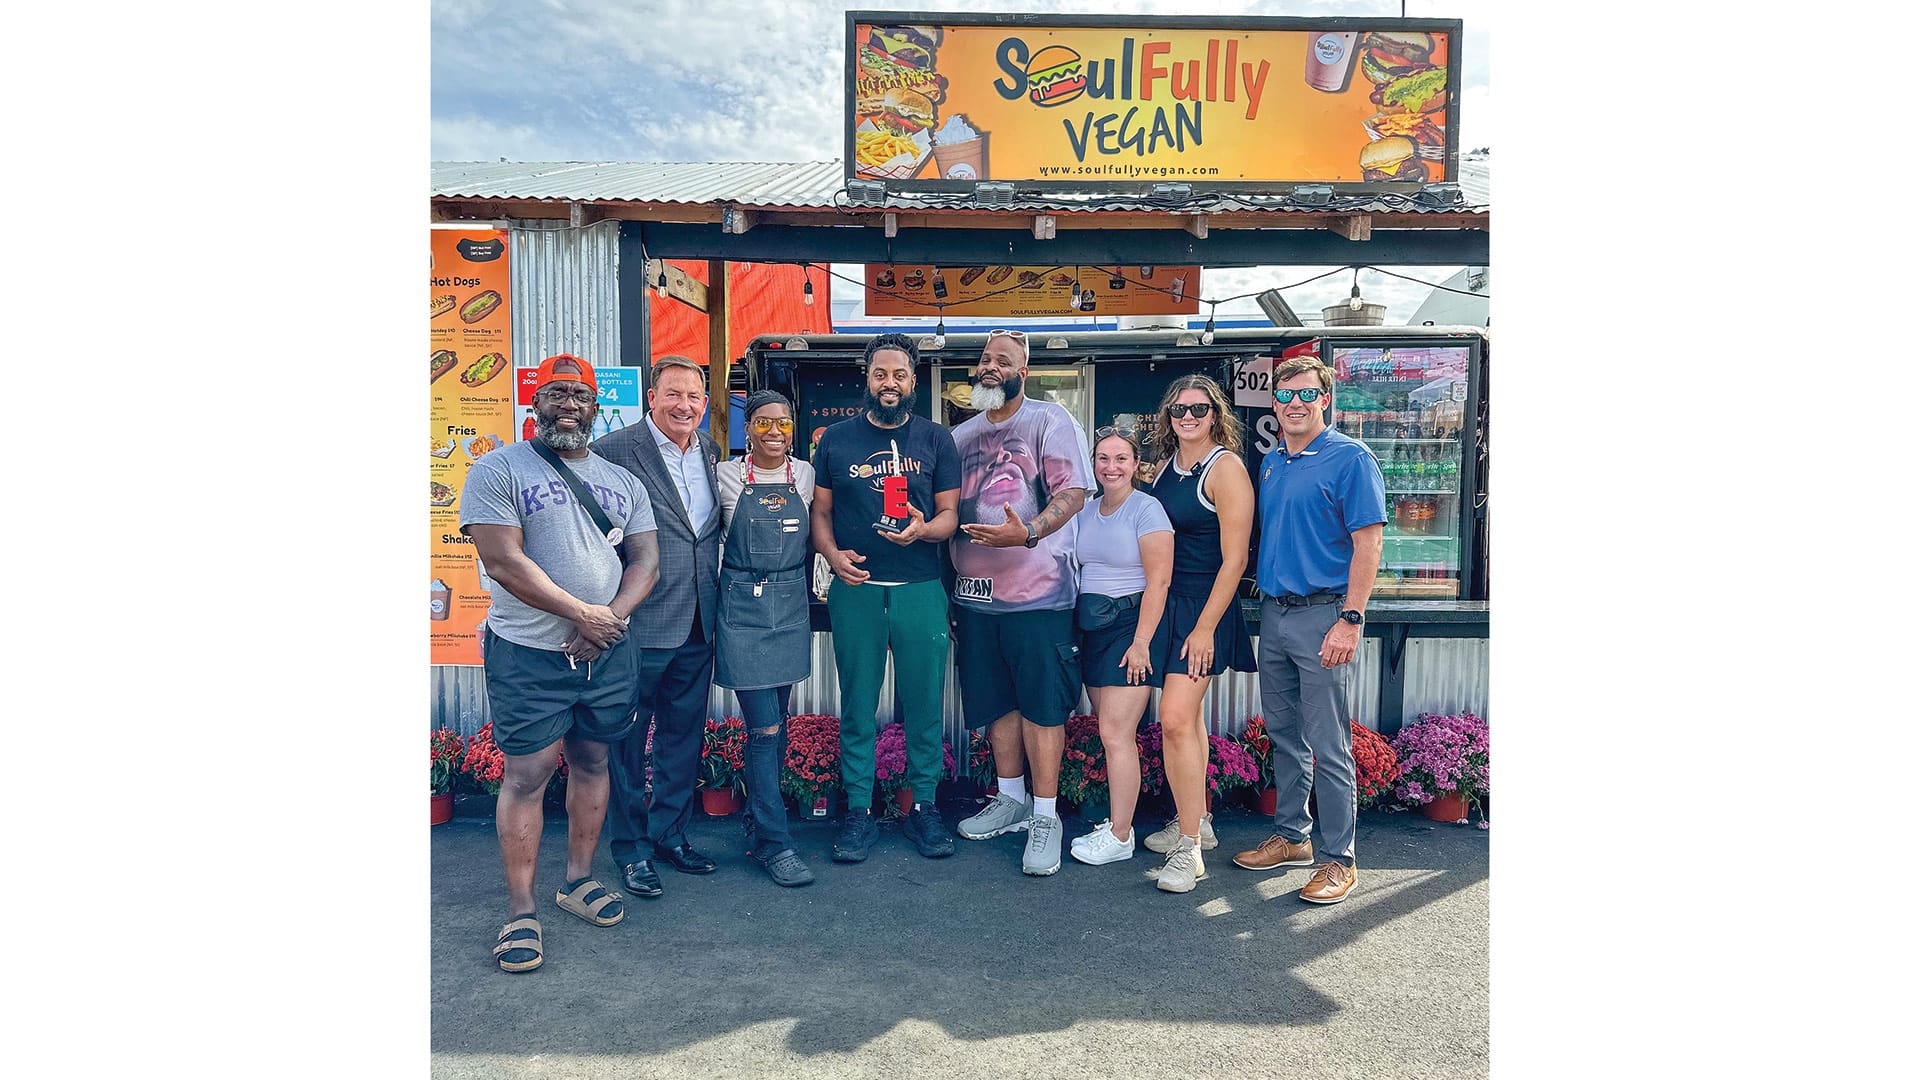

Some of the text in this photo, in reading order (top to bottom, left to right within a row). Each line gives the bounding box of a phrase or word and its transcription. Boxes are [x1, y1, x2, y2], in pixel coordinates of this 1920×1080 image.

[1063, 101, 1202, 163] VEGAN
[1039, 165, 1219, 177] www.soulfullyvegan.com
[453, 276, 480, 288] Dogs
[1237, 371, 1269, 391] 502
[598, 387, 619, 402] $4
[821, 407, 864, 417] SPICY
[447, 425, 477, 436] Fries
[521, 480, 627, 520] K-STE
